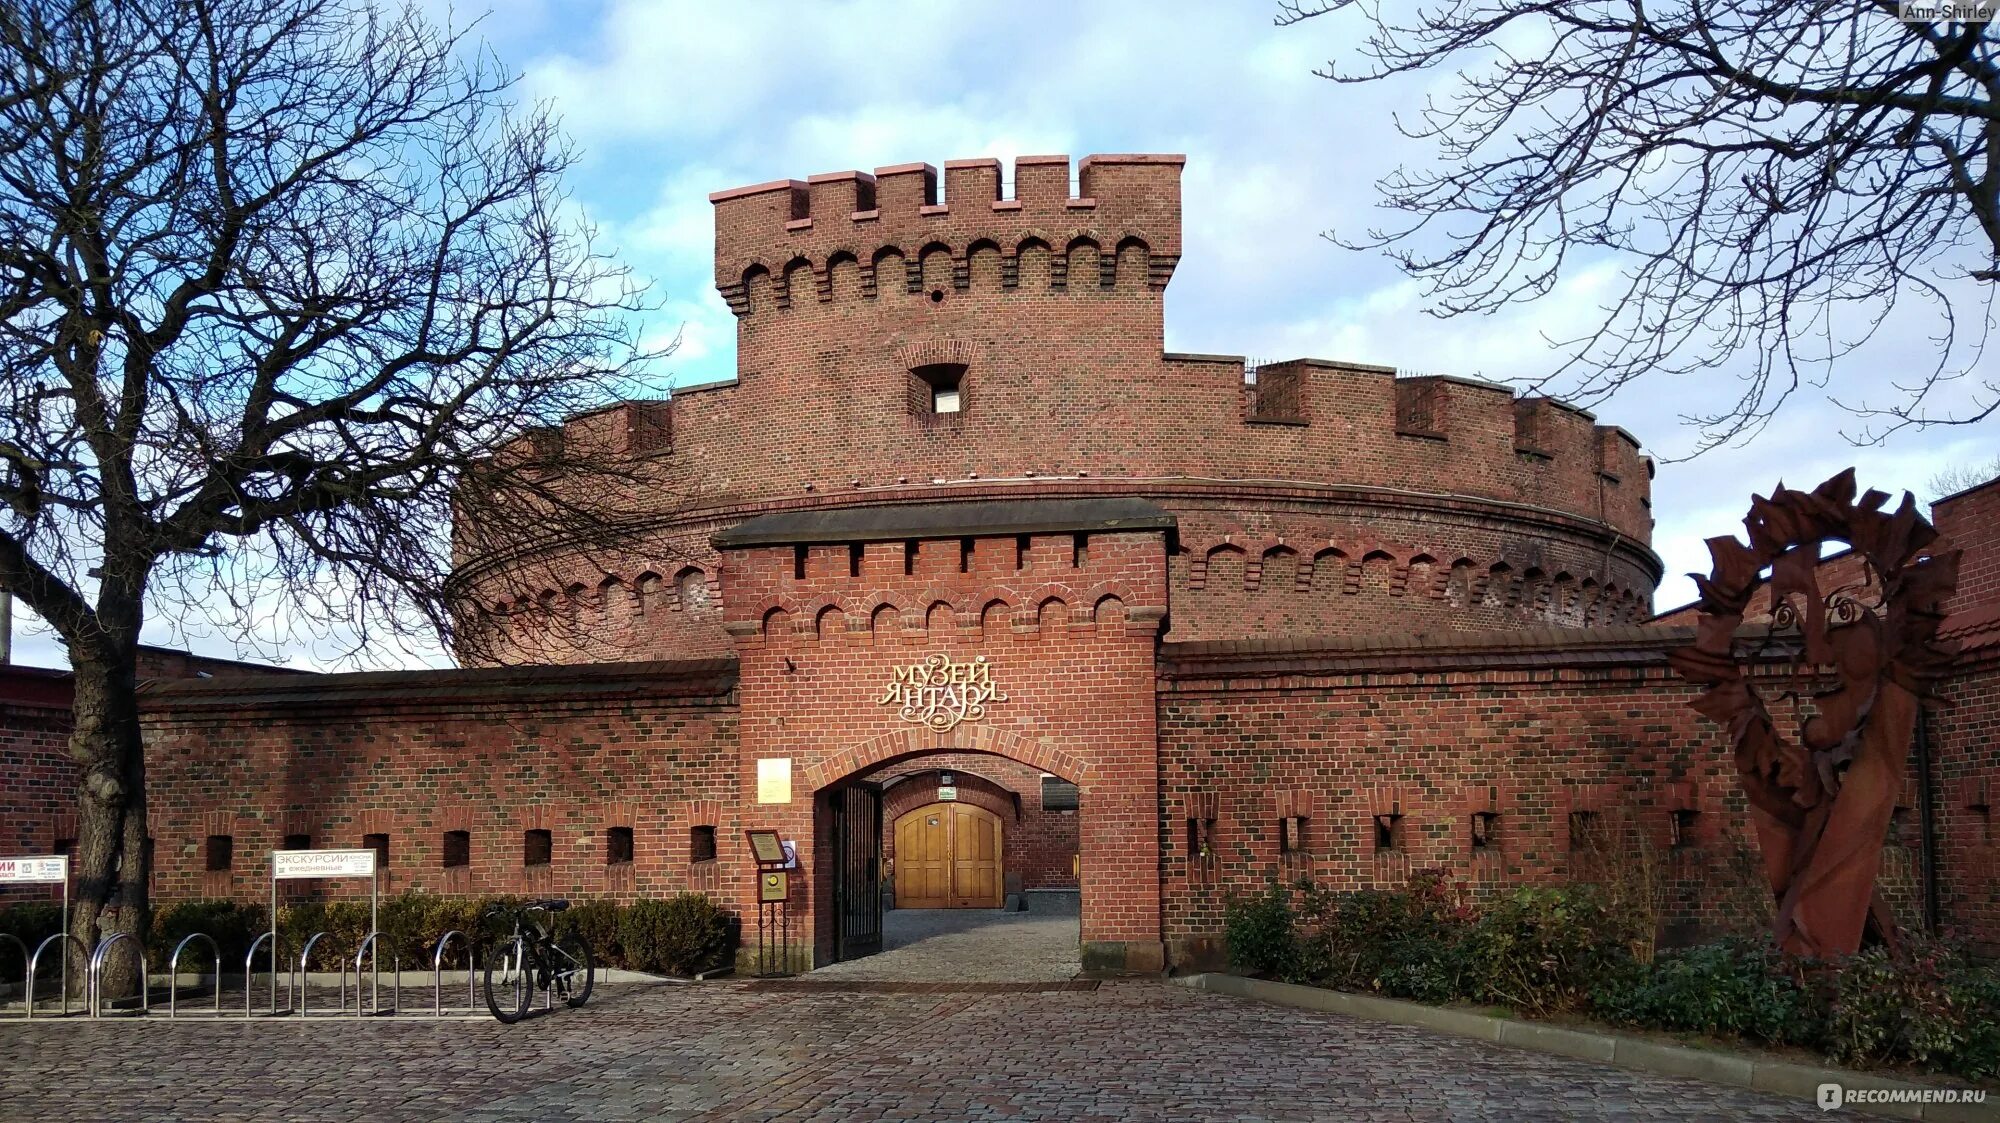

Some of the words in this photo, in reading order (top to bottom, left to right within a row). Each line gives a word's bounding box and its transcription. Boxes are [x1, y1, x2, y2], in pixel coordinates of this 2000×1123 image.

[892, 654, 993, 687] МУЗЕЙ
[876, 680, 1008, 728] ЯНТАРЯ
[277, 854, 349, 864] ЭКСКУРСИИ
[288, 865, 343, 873] ежедневные
